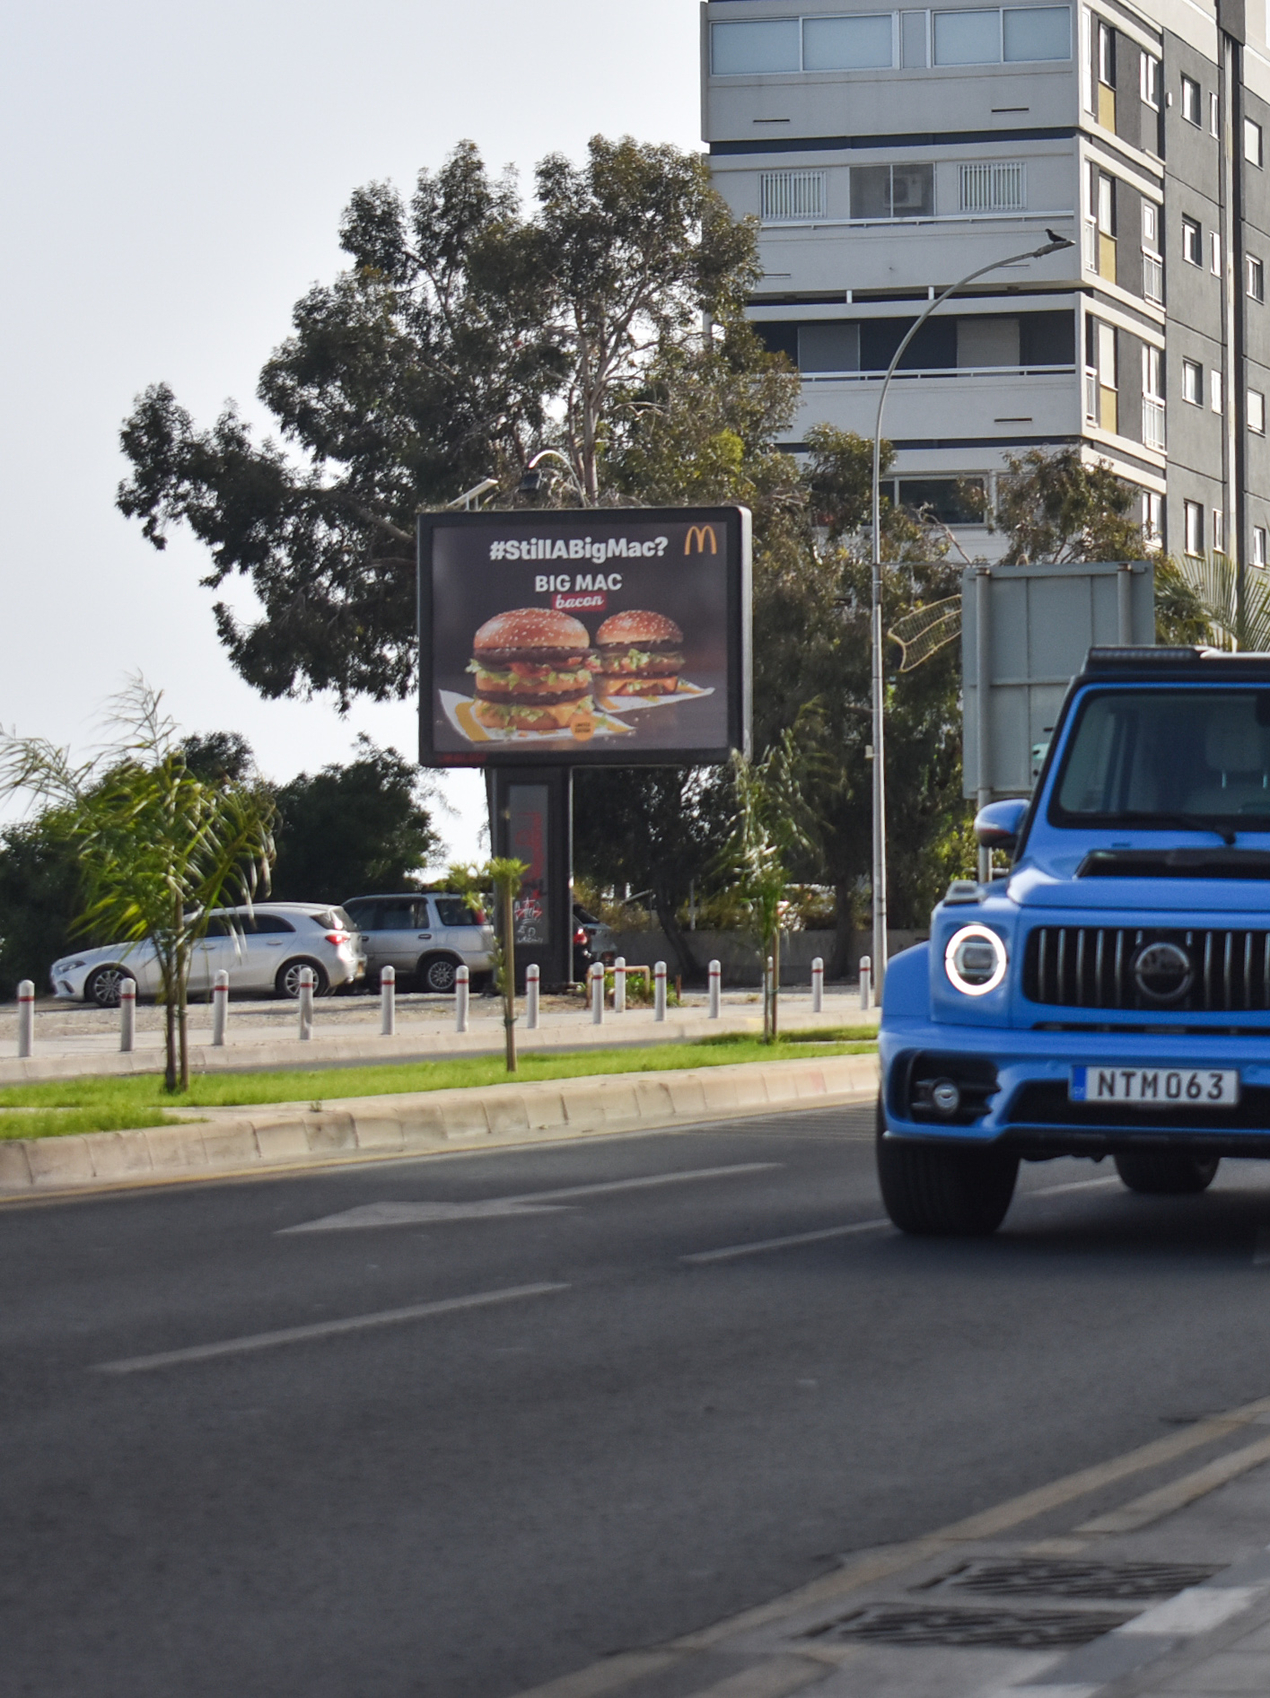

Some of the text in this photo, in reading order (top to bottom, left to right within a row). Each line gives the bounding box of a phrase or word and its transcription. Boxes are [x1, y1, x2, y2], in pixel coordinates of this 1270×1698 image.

[489, 536, 669, 564] #StillABigMac?
[534, 573, 623, 593] BIG MAC
[555, 594, 604, 610] bacon
